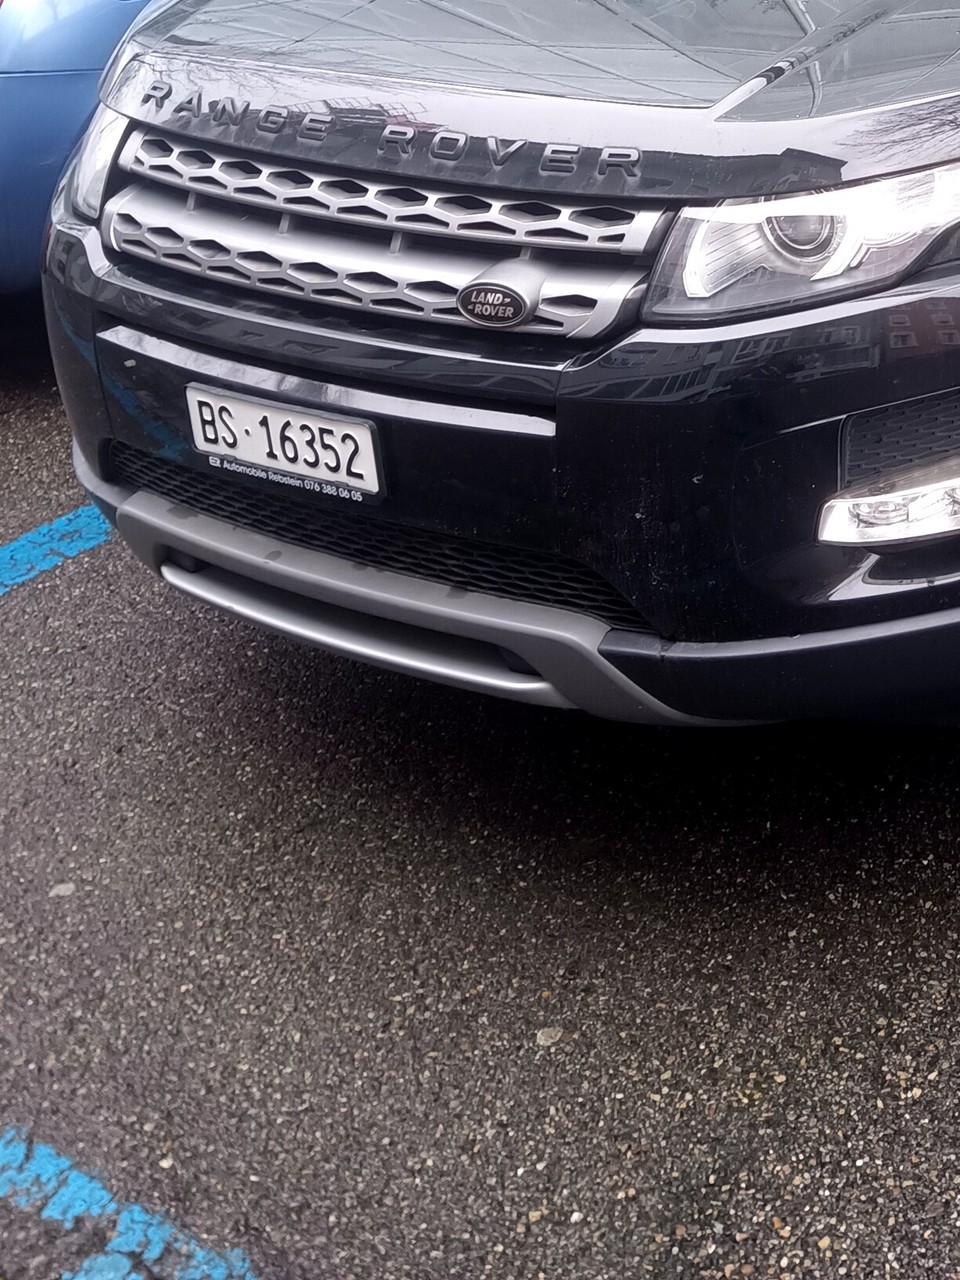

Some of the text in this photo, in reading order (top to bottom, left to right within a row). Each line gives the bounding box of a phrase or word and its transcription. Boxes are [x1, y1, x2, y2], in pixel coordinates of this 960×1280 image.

[140, 80, 643, 178] RANGE ROVER
[474, 303, 514, 318] ROVER
[223, 459, 267, 480] Automobile
[267, 471, 303, 489] Rebstein
[304, 480, 320, 492] 076
[338, 488, 350, 499] 06
[351, 491, 363, 502] 05
